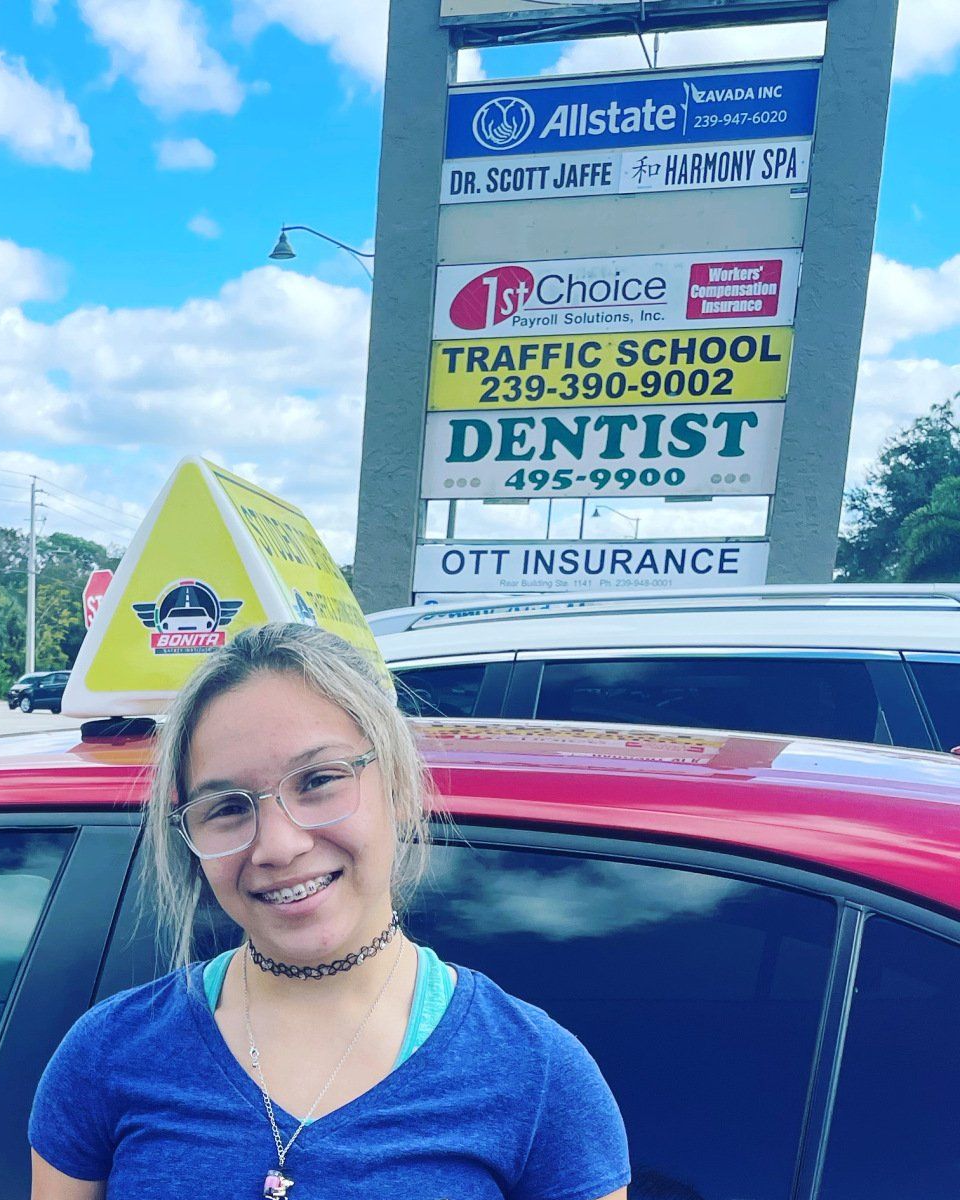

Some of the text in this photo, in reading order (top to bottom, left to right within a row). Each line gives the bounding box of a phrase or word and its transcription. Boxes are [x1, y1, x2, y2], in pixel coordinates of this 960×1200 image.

[695, 85, 782, 103] ZAVADA INC
[539, 98, 677, 139] Allstate
[693, 110, 787, 128] 239-947-6020
[450, 162, 613, 195] DR. SCOTT JAFFE
[632, 156, 661, 184] 和
[665, 147, 797, 185] HARMONY SPA
[708, 265, 763, 282] Workers'
[482, 271, 667, 328] 1st Choice
[690, 281, 778, 299] Compensation
[512, 310, 665, 329] Payroll Solutions, Inc.
[701, 299, 762, 314] Insurance
[442, 335, 781, 374] TRAFFIC SCHOOL
[479, 368, 734, 403] 239-390-9002
[445, 411, 758, 463] DENTIST
[505, 467, 685, 490] 495-9900
[441, 547, 740, 575] OTT INSURANCE
[156, 632, 220, 647] BONITA
